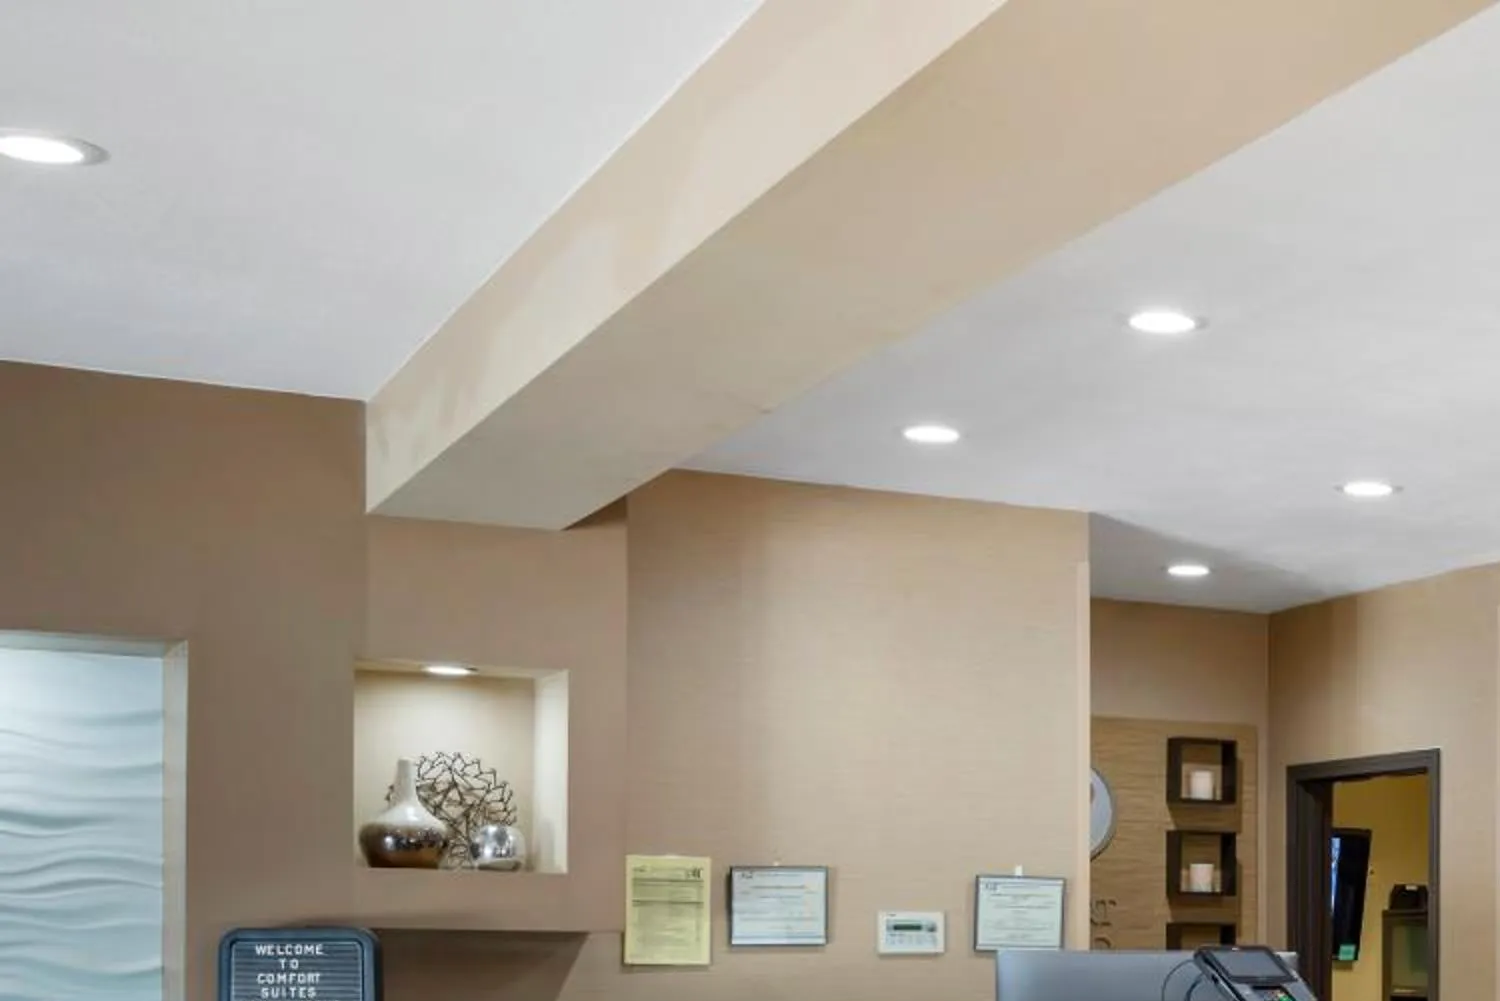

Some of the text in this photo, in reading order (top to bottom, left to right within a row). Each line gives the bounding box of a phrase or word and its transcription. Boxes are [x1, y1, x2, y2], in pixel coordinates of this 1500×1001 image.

[255, 944, 324, 956] WELCOME
[278, 958, 300, 970] TO
[257, 973, 321, 984] COMFORT
[261, 987, 317, 998] SUITES
